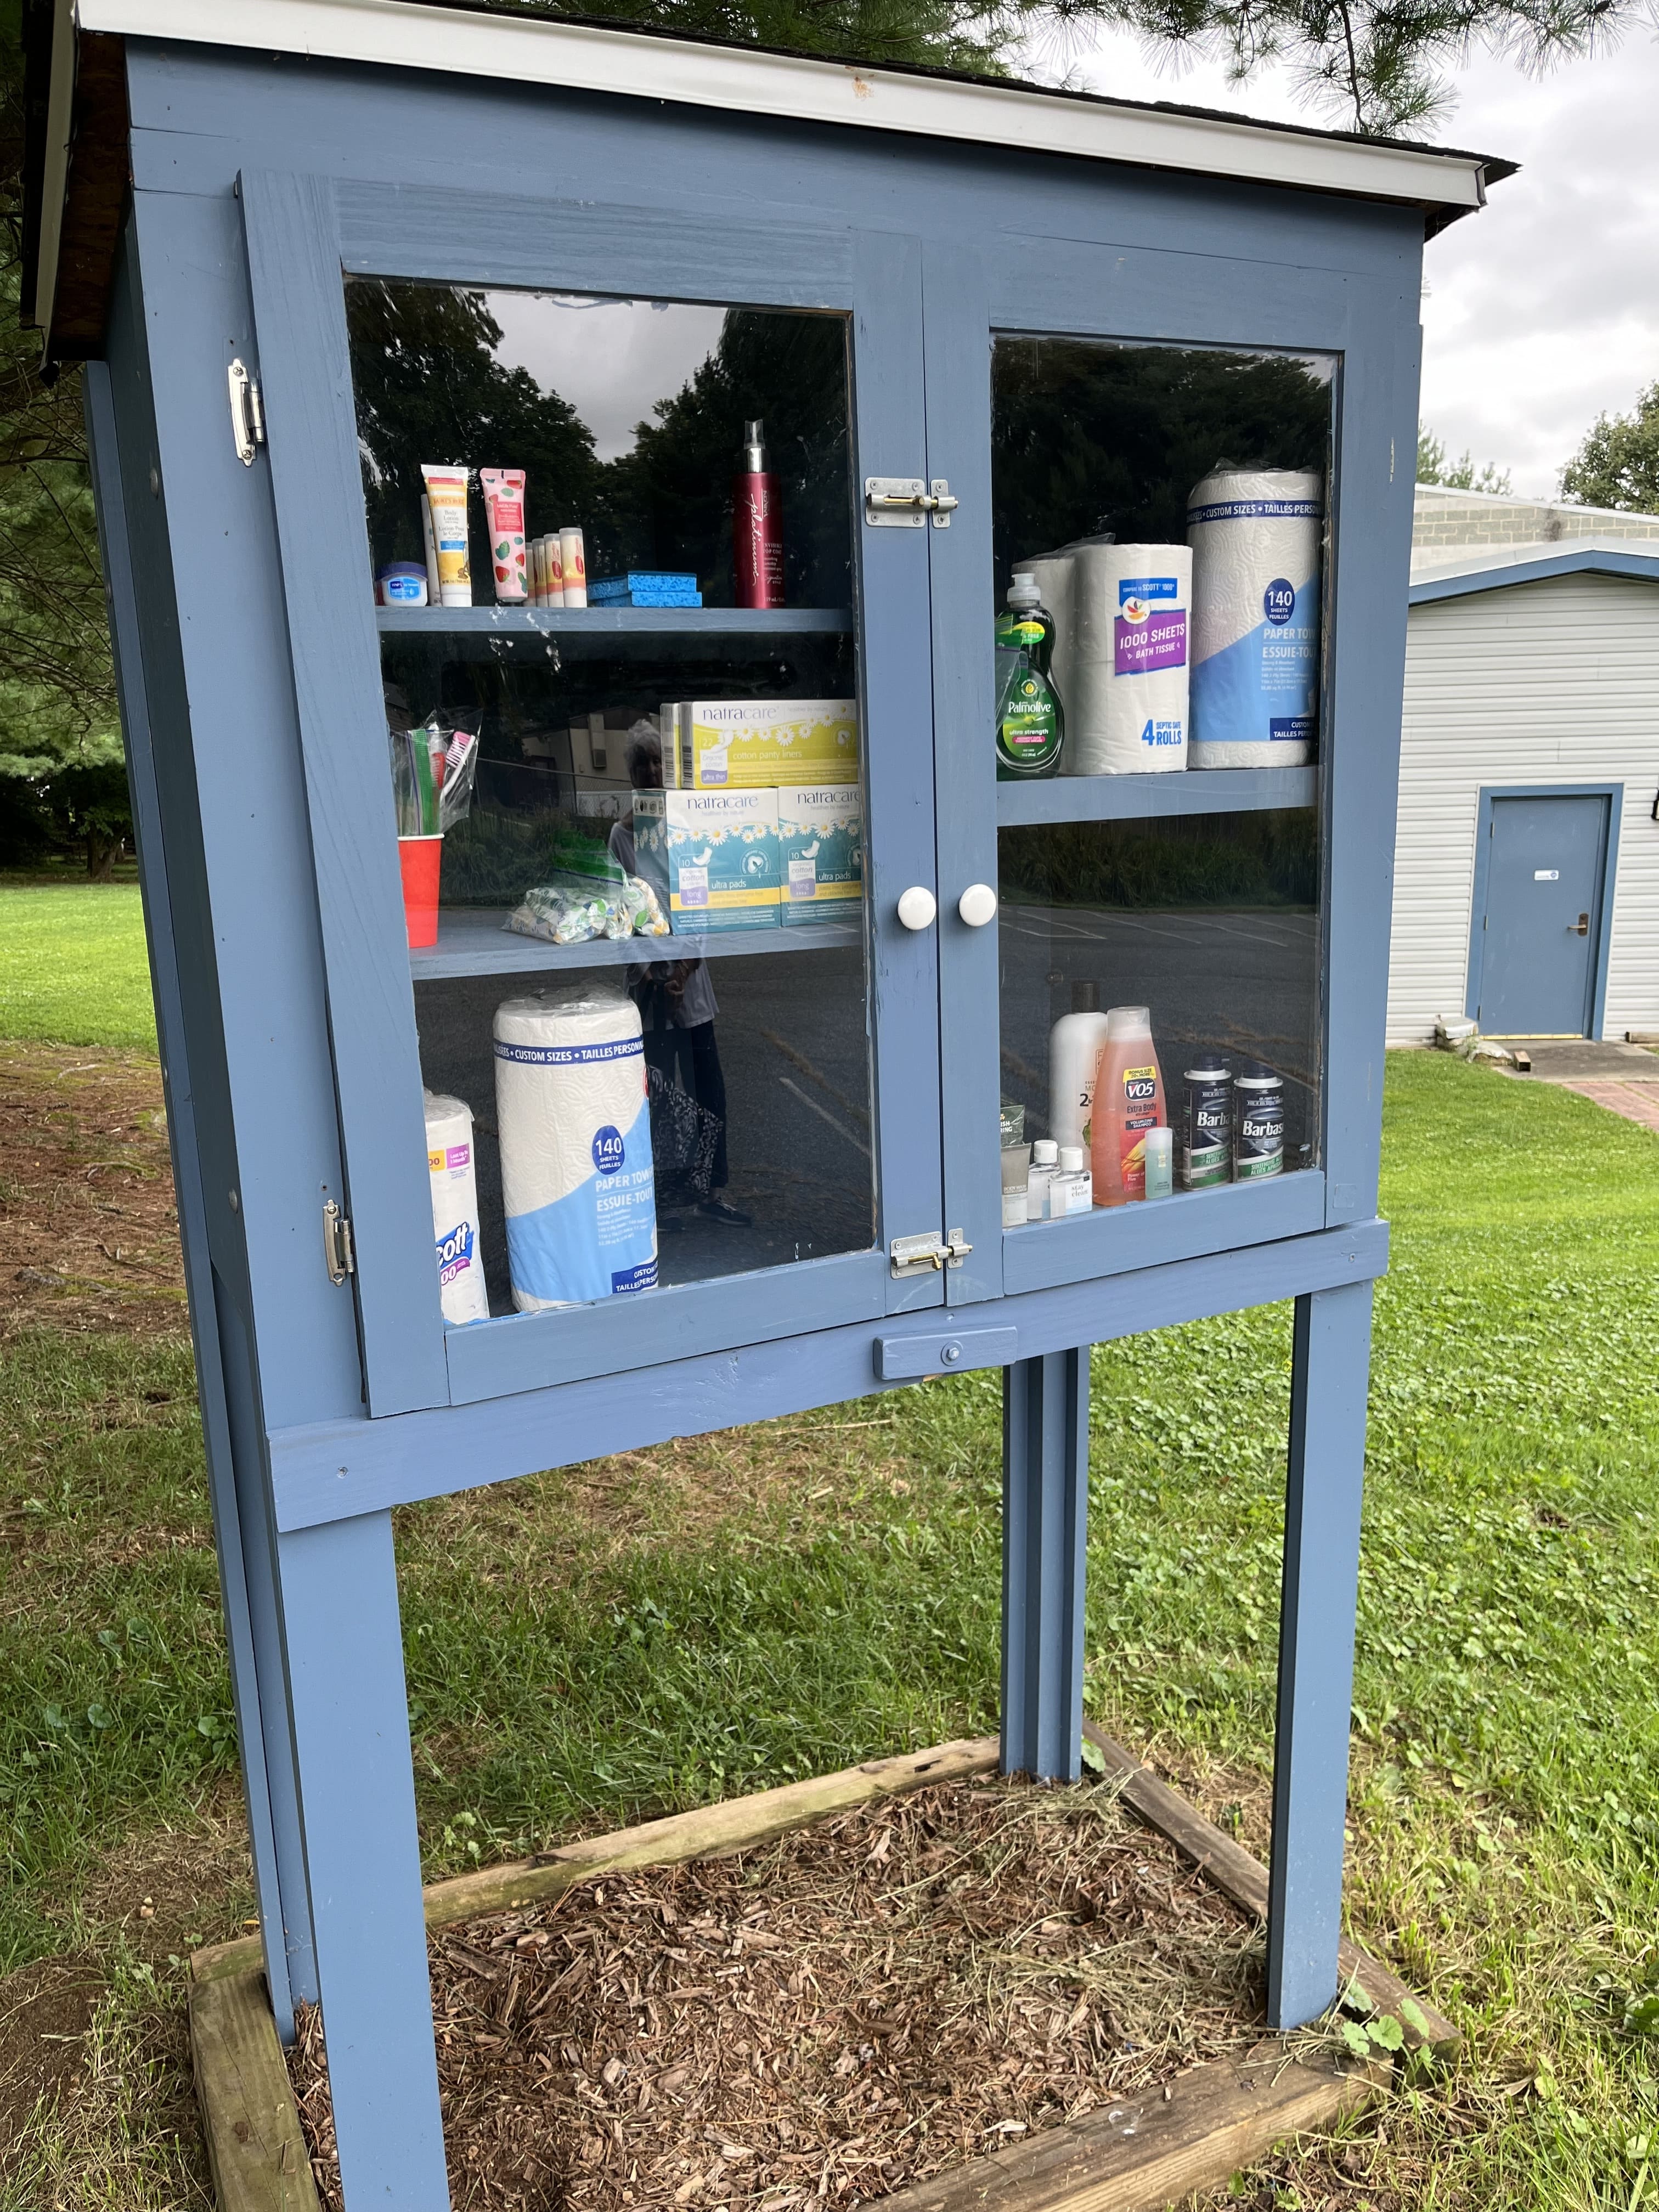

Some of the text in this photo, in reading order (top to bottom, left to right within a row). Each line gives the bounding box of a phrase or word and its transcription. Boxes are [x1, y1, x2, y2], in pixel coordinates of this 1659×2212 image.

[1206, 506, 1232, 518] CUSTOM
[1234, 504, 1256, 515] SIZES
[1264, 504, 1293, 514] TAILLES
[744, 493, 763, 586] platinum
[1268, 591, 1293, 606] 140
[1120, 623, 1185, 650] 1000 SHEETS
[1263, 628, 1295, 640] PAPER
[1136, 642, 1176, 659] BATH TISSUE
[703, 707, 777, 720] natracare
[1008, 701, 1052, 714] Palmolive
[1156, 721, 1172, 730] SEPTIC
[1141, 719, 1155, 746] 4
[1156, 730, 1182, 746] ROLLS
[702, 737, 713, 747] 22
[759, 751, 780, 760] panty
[782, 749, 803, 758] liners
[687, 796, 759, 810] natracare
[798, 791, 860, 804] natracare
[682, 859, 690, 867] 10
[819, 871, 851, 882] ultra pads
[711, 879, 747, 890] ultra pads
[795, 882, 809, 890] long
[687, 890, 702, 899] long
[515, 1049, 545, 1062] CUSTOM
[547, 1051, 572, 1062] SIZES
[581, 1047, 613, 1059] TAILLES
[1127, 1081, 1154, 1098] VO5
[1127, 1102, 1157, 1114] Extra Body
[595, 1137, 622, 1156] 140
[599, 1162, 622, 1170] FEUILLES
[595, 1175, 630, 1193] PAPER
[596, 1186, 653, 1212] ESSUIE-TOUT
[1071, 1189, 1088, 1198] clean
[616, 1280, 640, 1292] TAILLES
